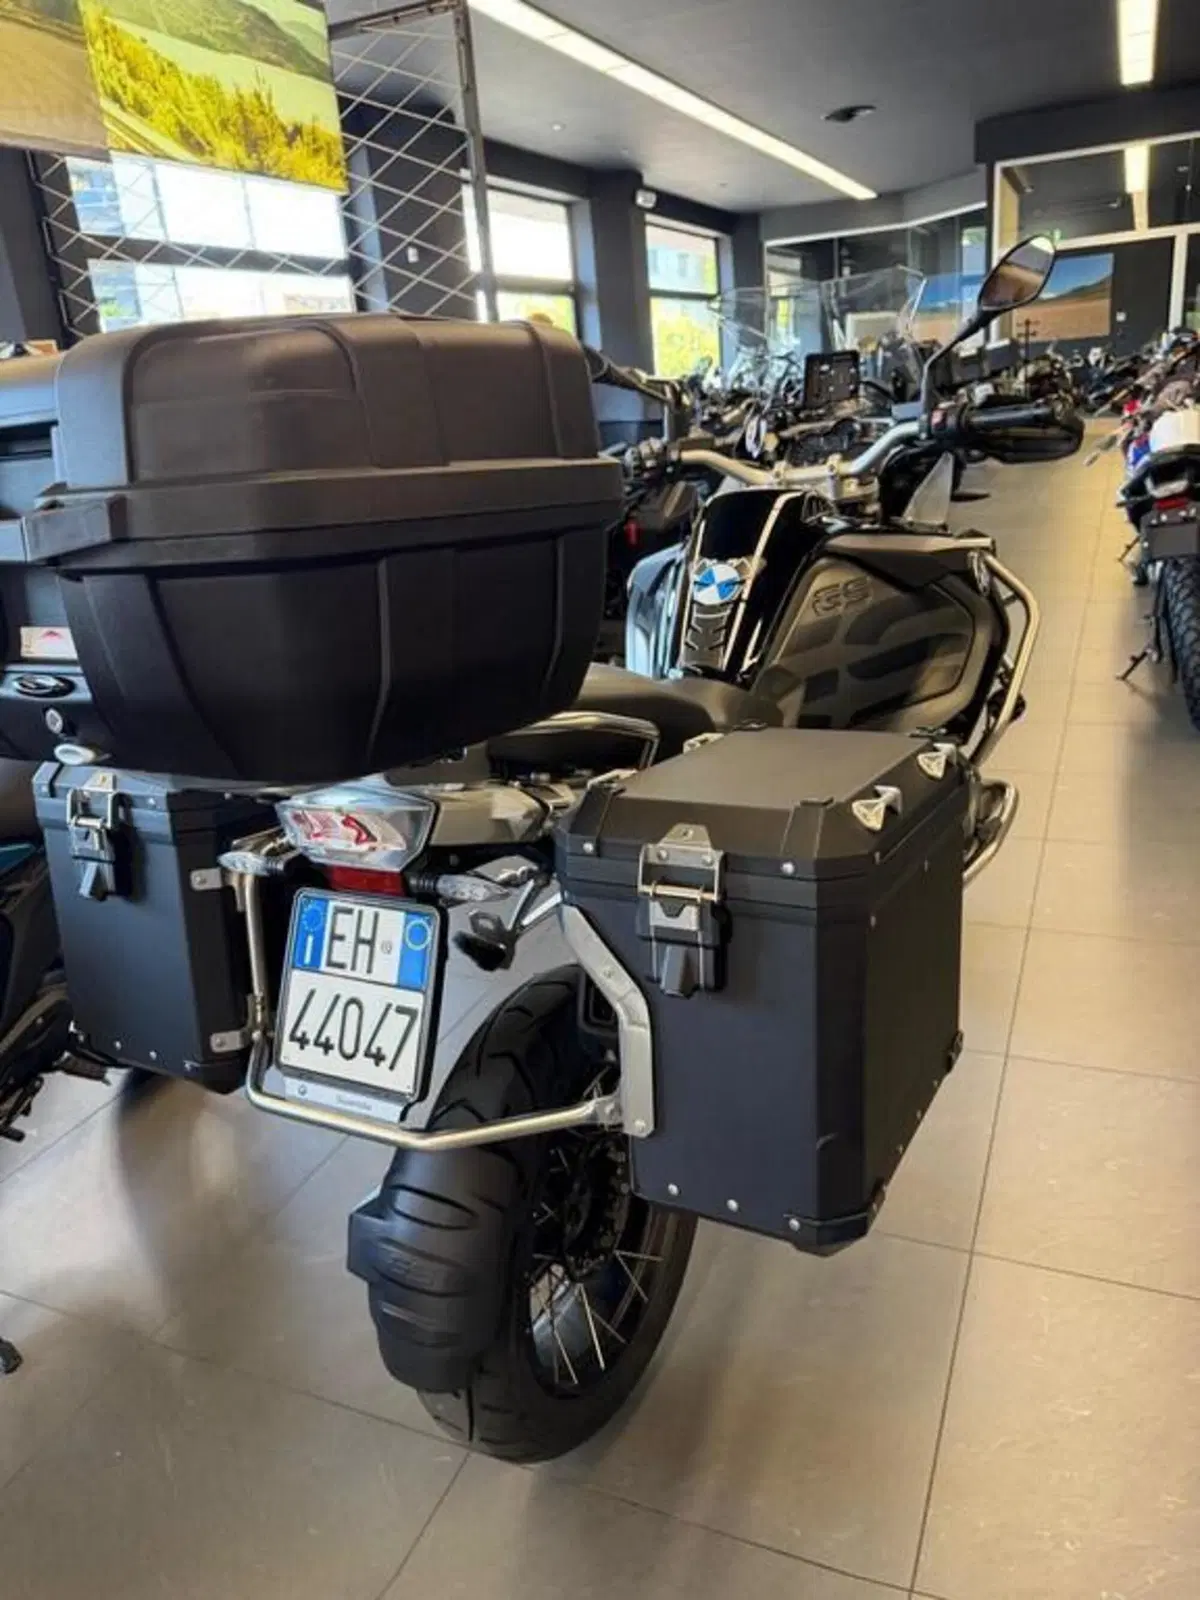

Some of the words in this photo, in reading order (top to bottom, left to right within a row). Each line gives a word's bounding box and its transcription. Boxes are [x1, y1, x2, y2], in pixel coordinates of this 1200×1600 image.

[812, 577, 869, 614] GS
[326, 906, 379, 974] EH
[289, 988, 419, 1071] 44047
